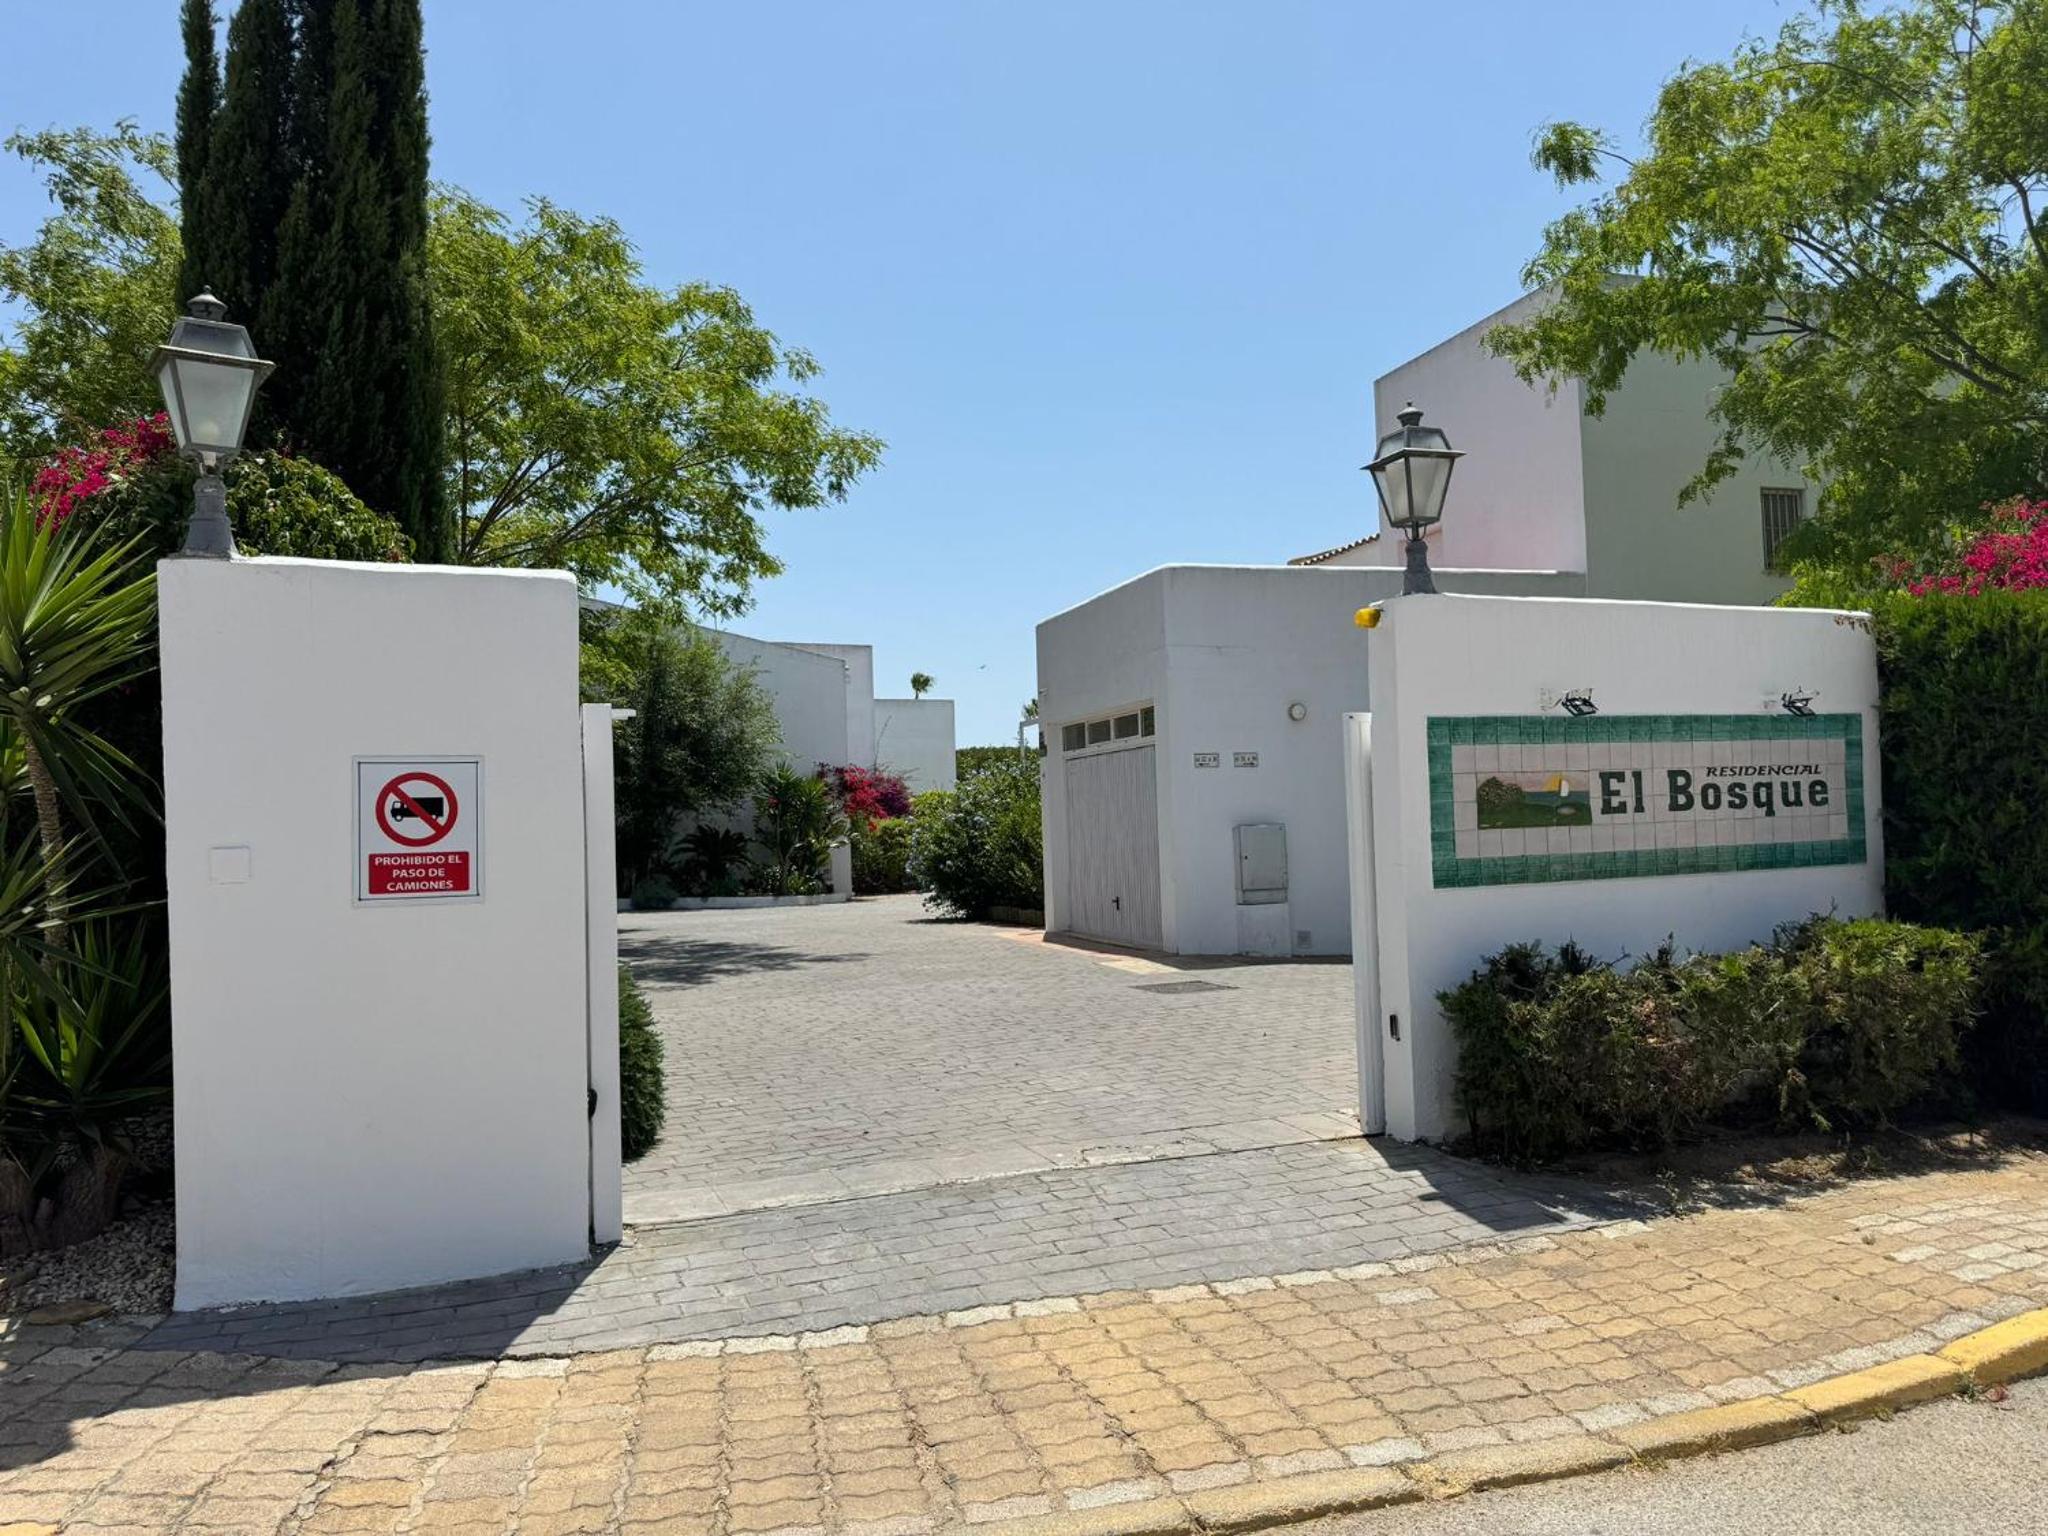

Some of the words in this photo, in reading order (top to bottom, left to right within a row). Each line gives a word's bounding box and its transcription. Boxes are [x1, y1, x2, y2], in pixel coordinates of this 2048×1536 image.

[1706, 764, 1823, 777] RESIDENCIAL
[1599, 770, 1645, 815] El
[1667, 769, 1829, 817] Bosque
[374, 855, 445, 866] PROHIBIDO
[447, 854, 462, 864] EL
[392, 869, 425, 878] PASO
[428, 868, 445, 877] DE
[386, 881, 453, 891] CAMIONES
